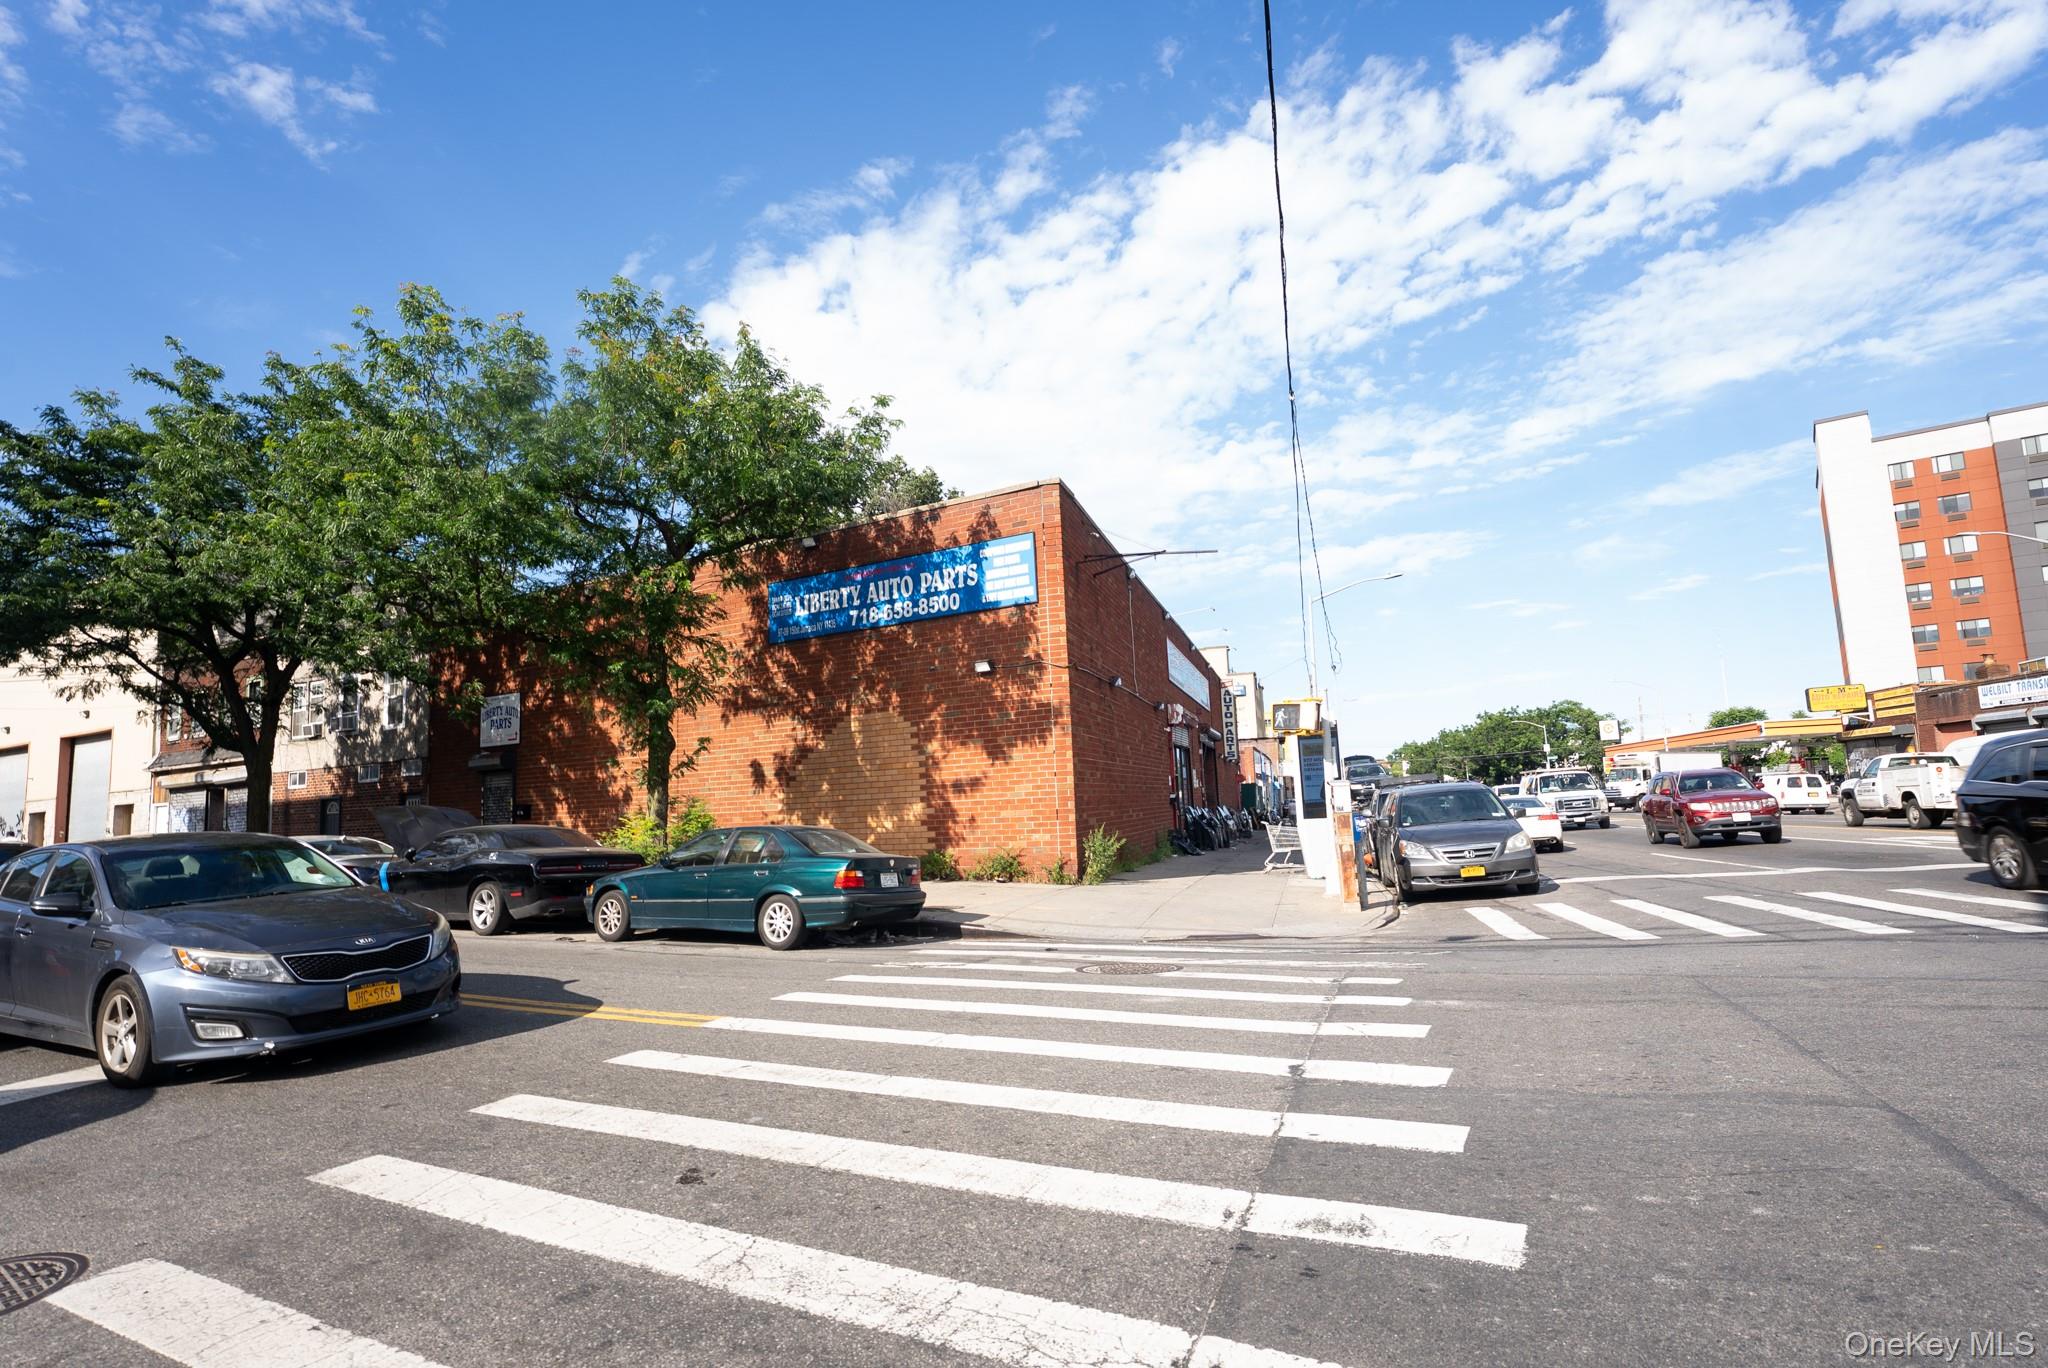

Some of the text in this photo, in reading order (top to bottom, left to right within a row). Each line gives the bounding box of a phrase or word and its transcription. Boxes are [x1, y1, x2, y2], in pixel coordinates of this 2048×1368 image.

[794, 585, 861, 617] LIBERTY
[866, 575, 914, 603] AUTO
[920, 563, 979, 595] PARTS
[849, 592, 960, 626] 718-658-8500
[816, 621, 824, 631] NY
[1981, 683, 2012, 697] WELBILT
[505, 705, 519, 719] AUTO
[490, 717, 512, 730] PARTS
[1223, 689, 1236, 758] AUTO PARTS
[357, 937, 374, 945] KIA
